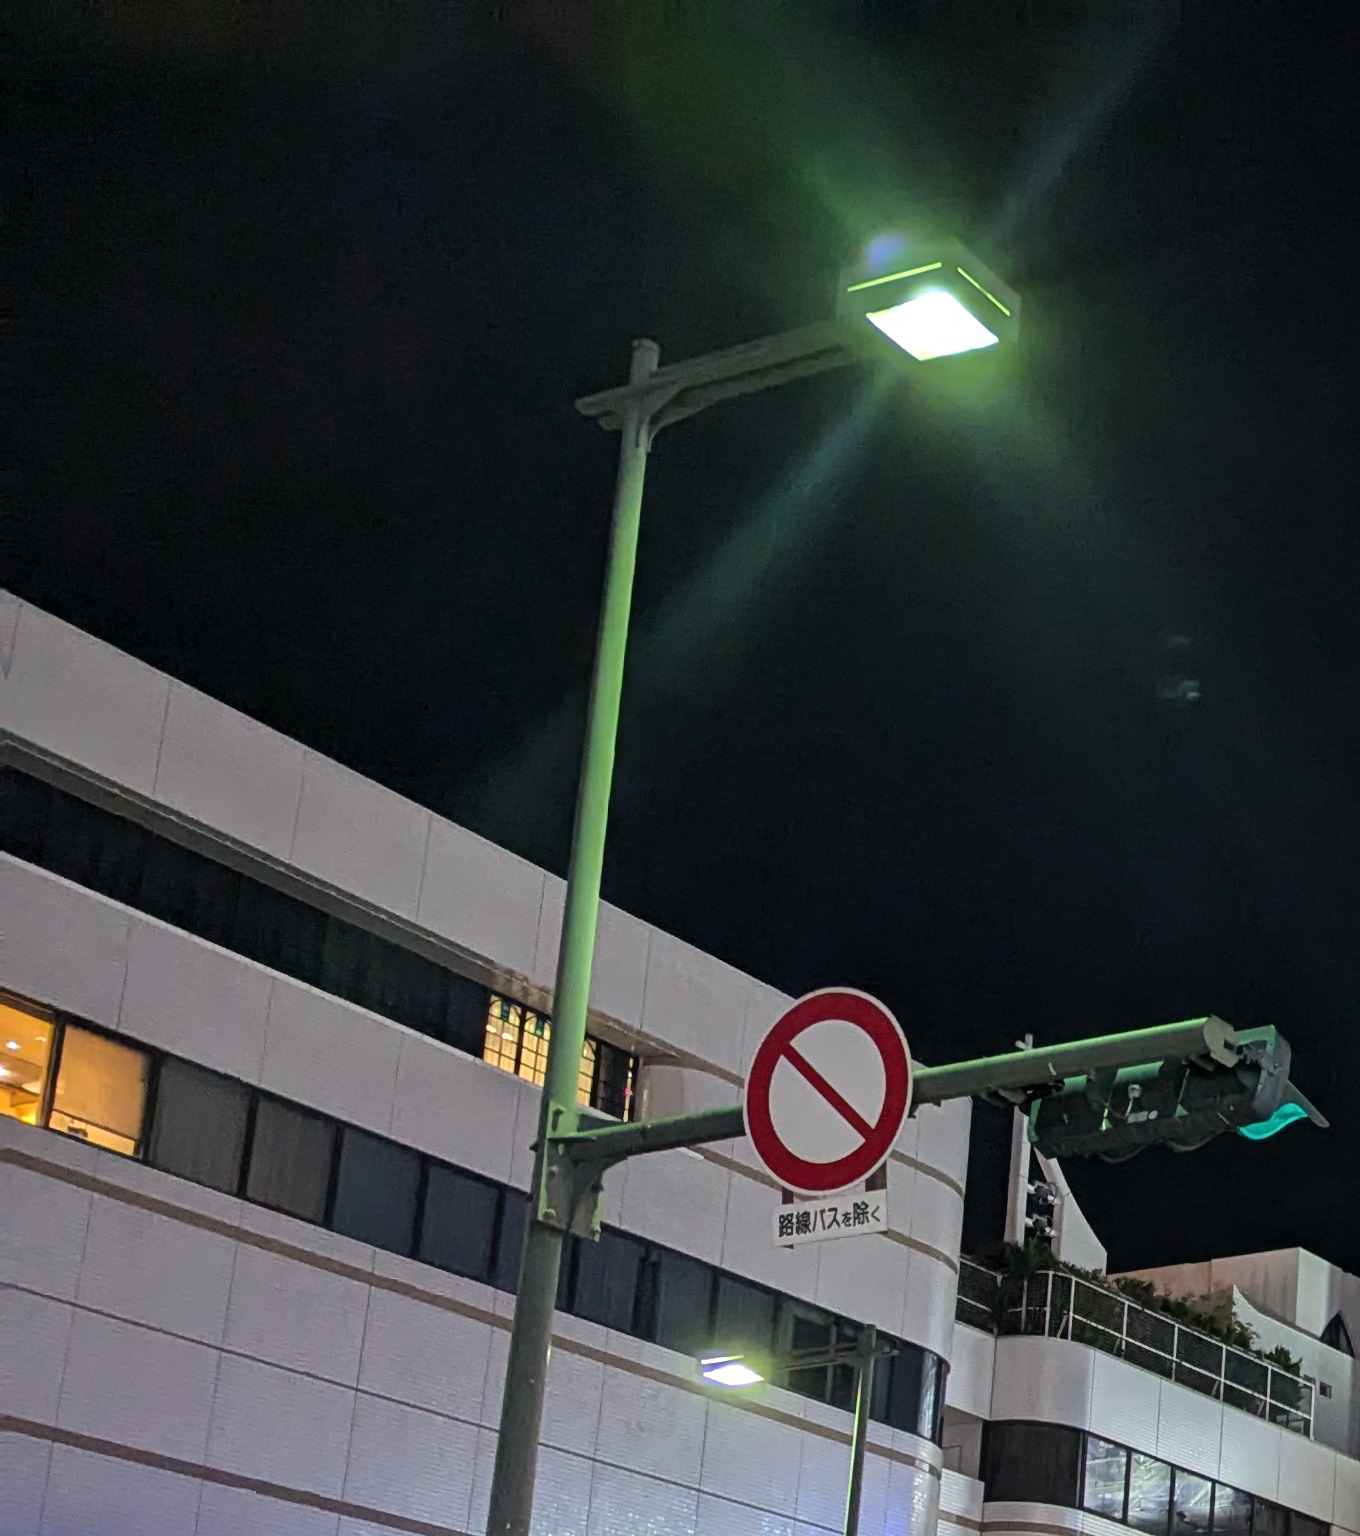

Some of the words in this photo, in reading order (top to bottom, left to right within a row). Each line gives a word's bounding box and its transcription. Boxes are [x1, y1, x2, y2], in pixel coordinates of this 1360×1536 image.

[778, 1201, 880, 1238] 路線バスを除く
